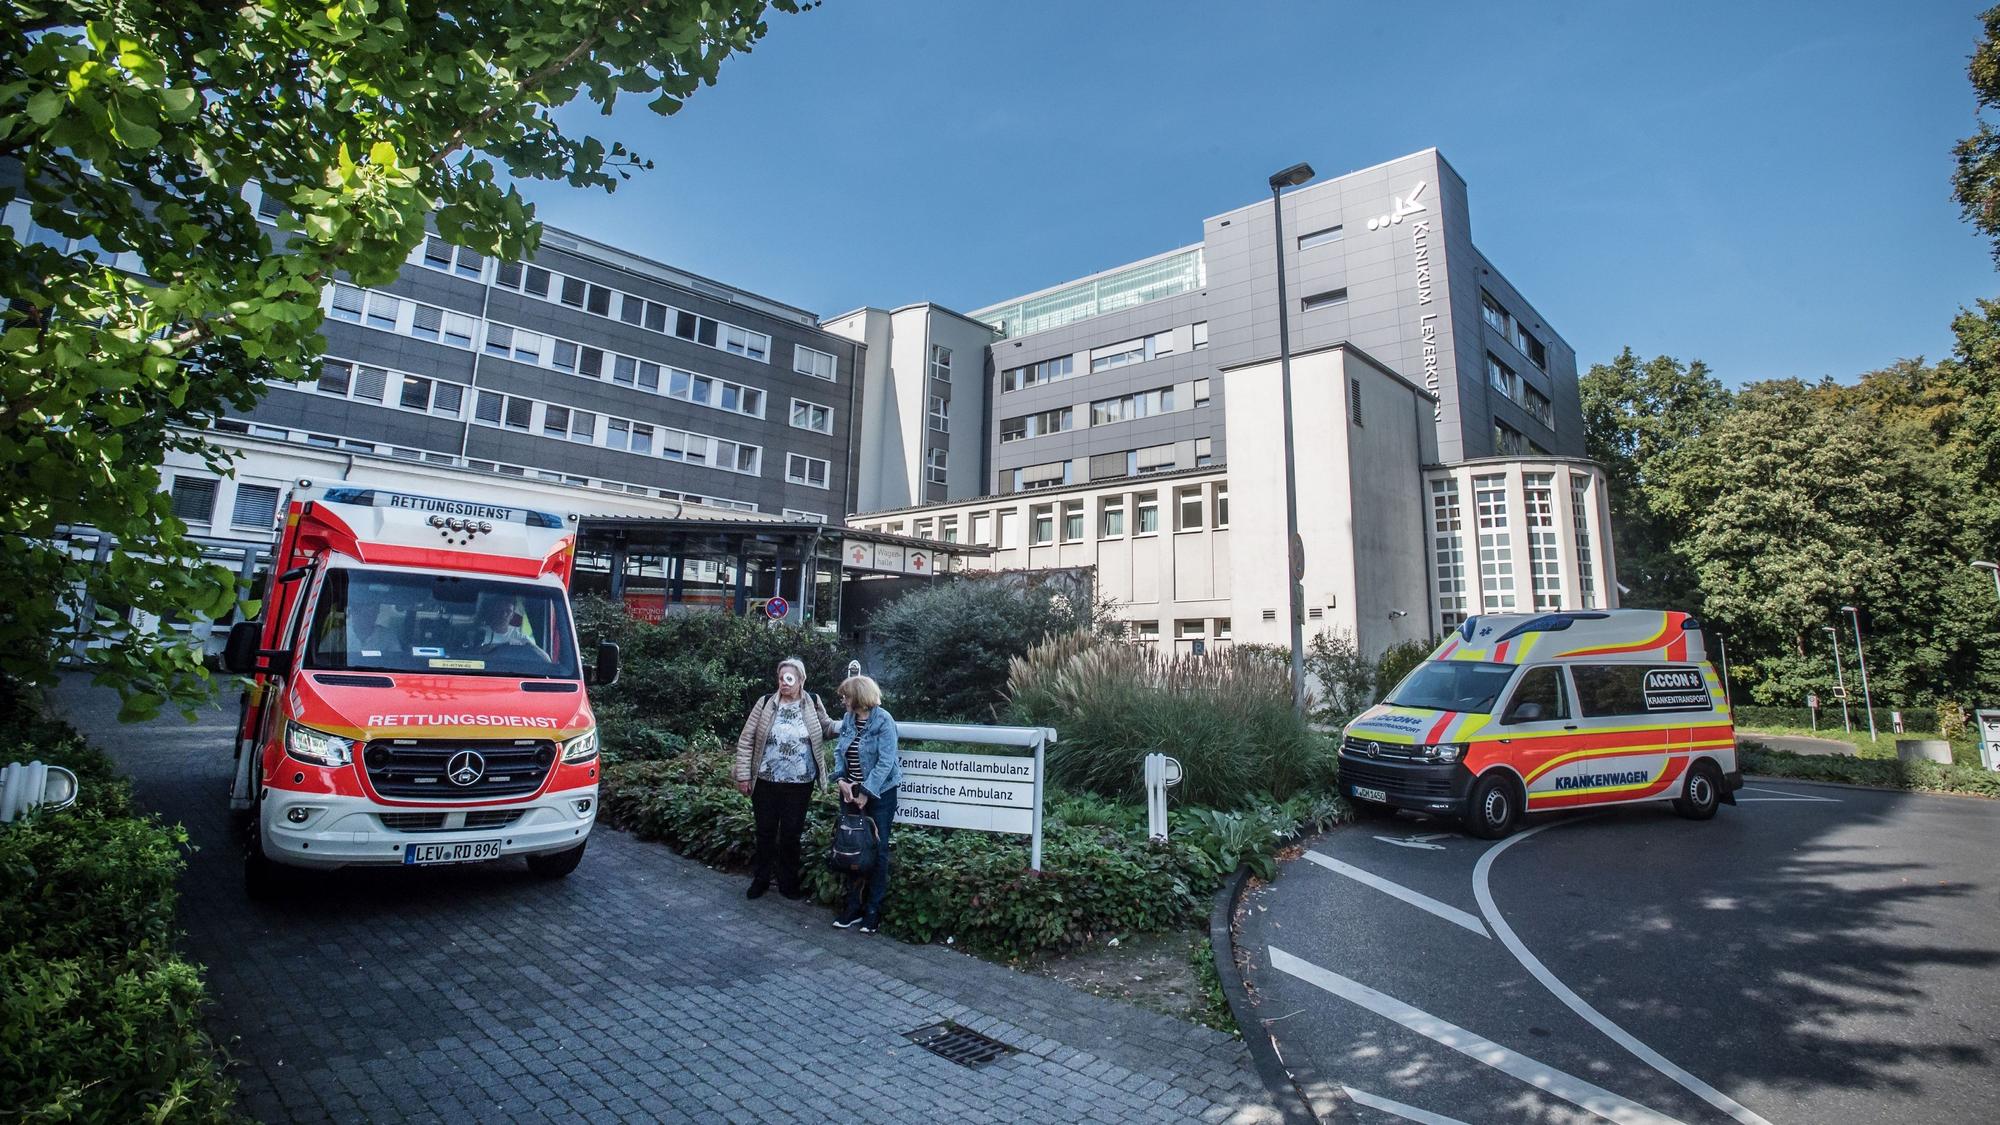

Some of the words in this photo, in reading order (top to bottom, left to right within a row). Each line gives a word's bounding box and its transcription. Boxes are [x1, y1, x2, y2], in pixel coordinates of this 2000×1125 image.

[1413, 220, 1432, 306] KLINIKUM
[390, 495, 513, 520] RETTUNGSDIENST
[1649, 673, 1691, 687] ACCON
[1648, 694, 1707, 705] KRANKENTRANSPORT
[368, 714, 557, 728] RETTUNGSDIENST
[941, 760, 1029, 776] Notfallambulanz
[1555, 770, 1648, 790] KRANKENWAGEN
[959, 786, 1013, 801] Ambulanz
[415, 846, 444, 861] LEV
[454, 844, 472, 859] RD
[474, 842, 499, 857] 896
